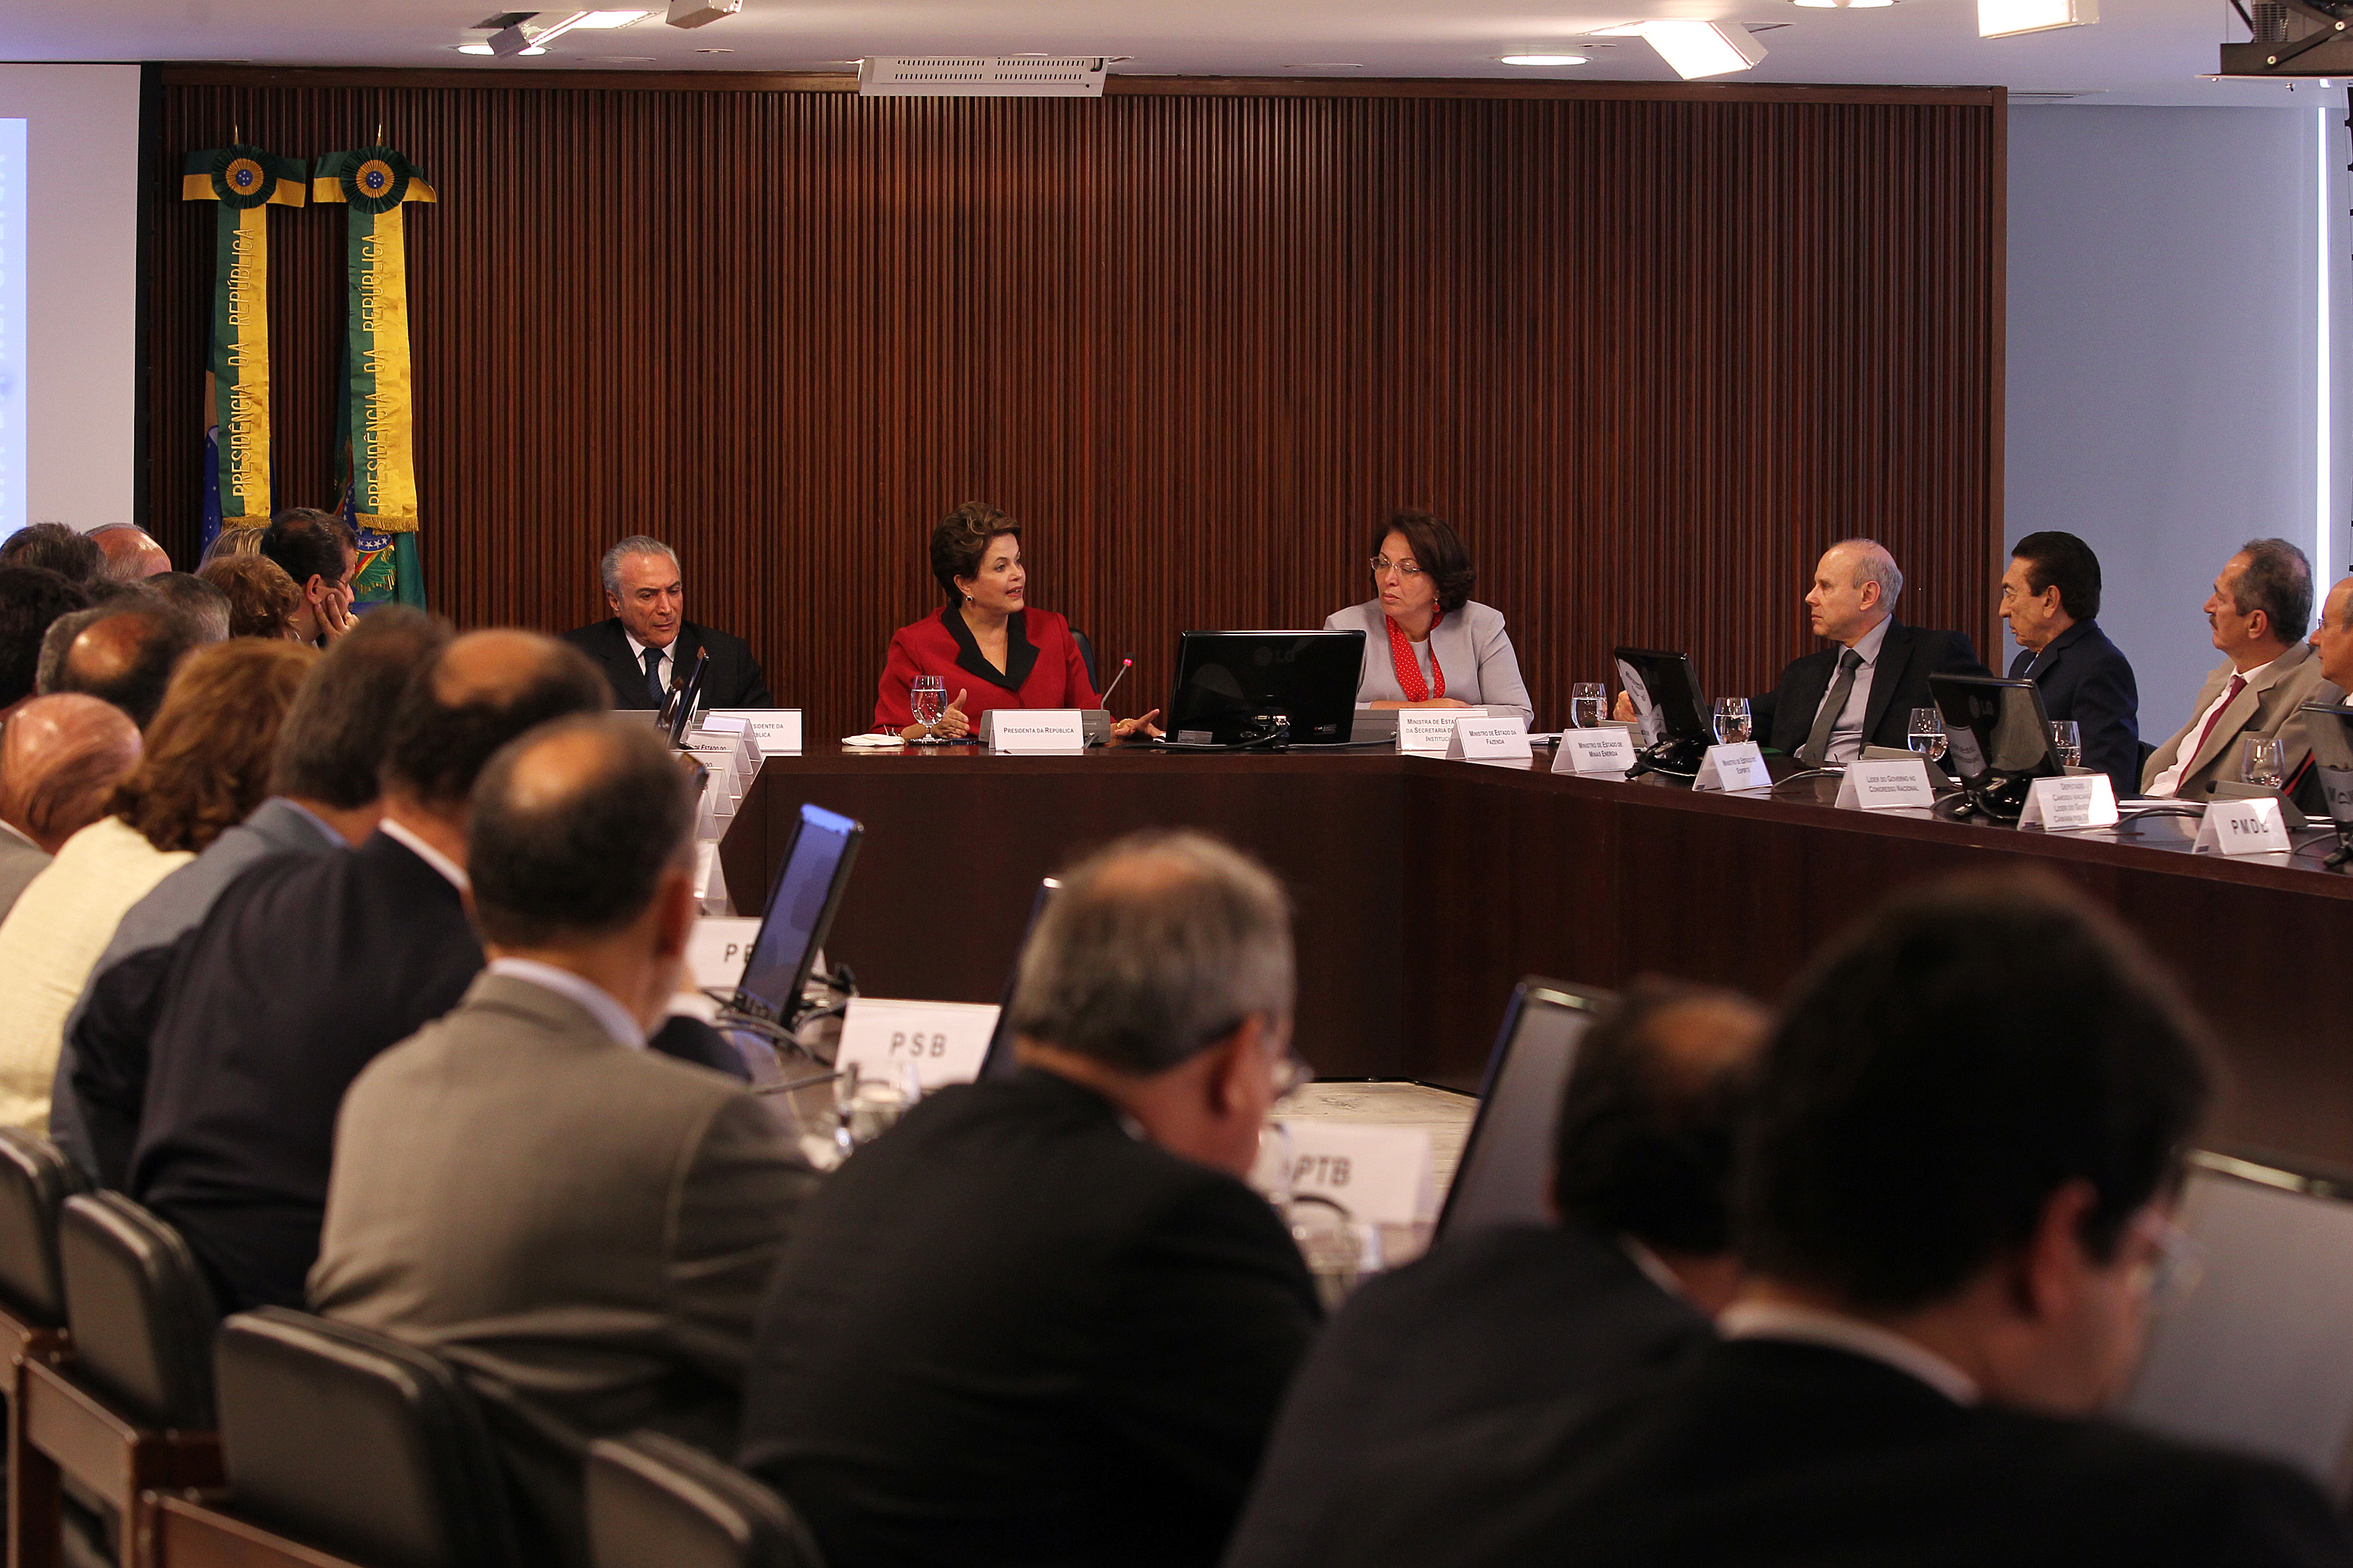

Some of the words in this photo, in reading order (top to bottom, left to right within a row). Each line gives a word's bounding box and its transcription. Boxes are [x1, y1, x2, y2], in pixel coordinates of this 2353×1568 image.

[228, 228, 254, 327] REPÚBLICA
[358, 233, 385, 333] REPÚBLICA
[228, 341, 250, 368] DA
[363, 347, 385, 374] DA
[228, 383, 253, 497] PRESIDÊNCIA
[364, 390, 390, 508] PRESIDÊNCIA
[890, 1031, 948, 1058] PSB
[1292, 1154, 1352, 1188] PTB
